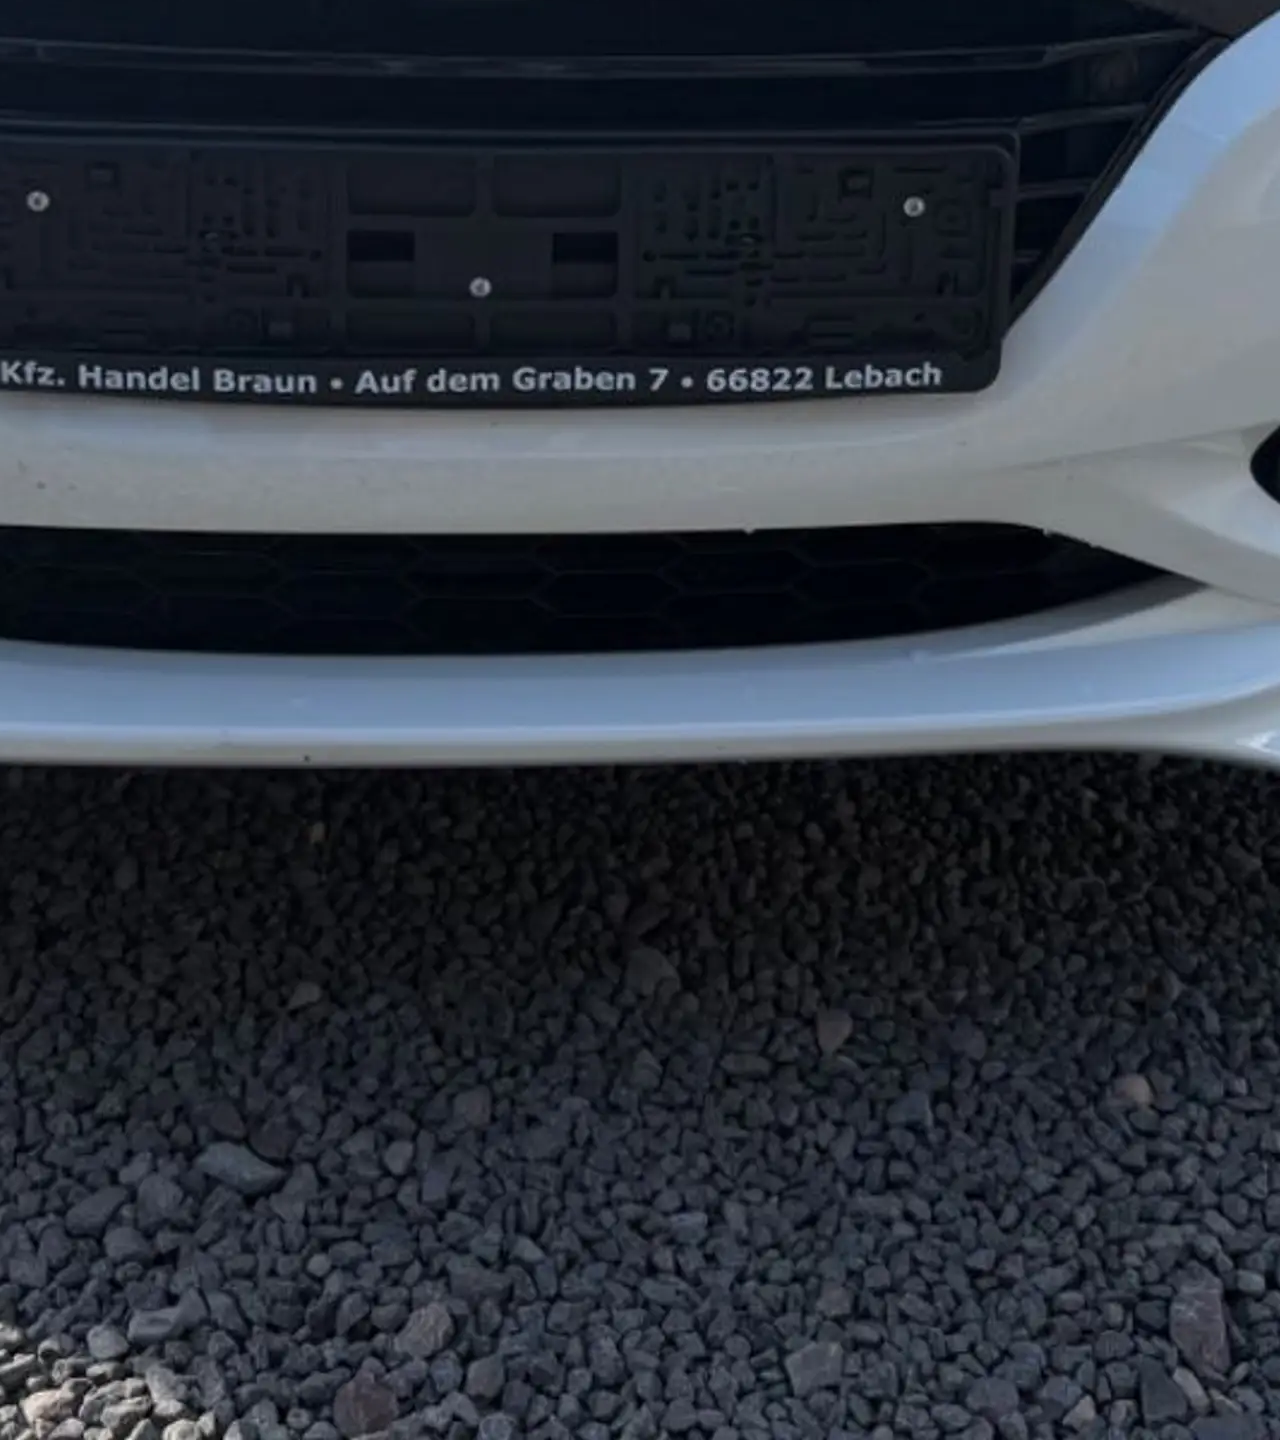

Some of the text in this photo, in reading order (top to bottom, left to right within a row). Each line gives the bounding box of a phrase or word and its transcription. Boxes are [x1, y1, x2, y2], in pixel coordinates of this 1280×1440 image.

[0, 360, 942, 394] Kfz. Handel Braun Auf dem Graben 7 66822 Lebach
